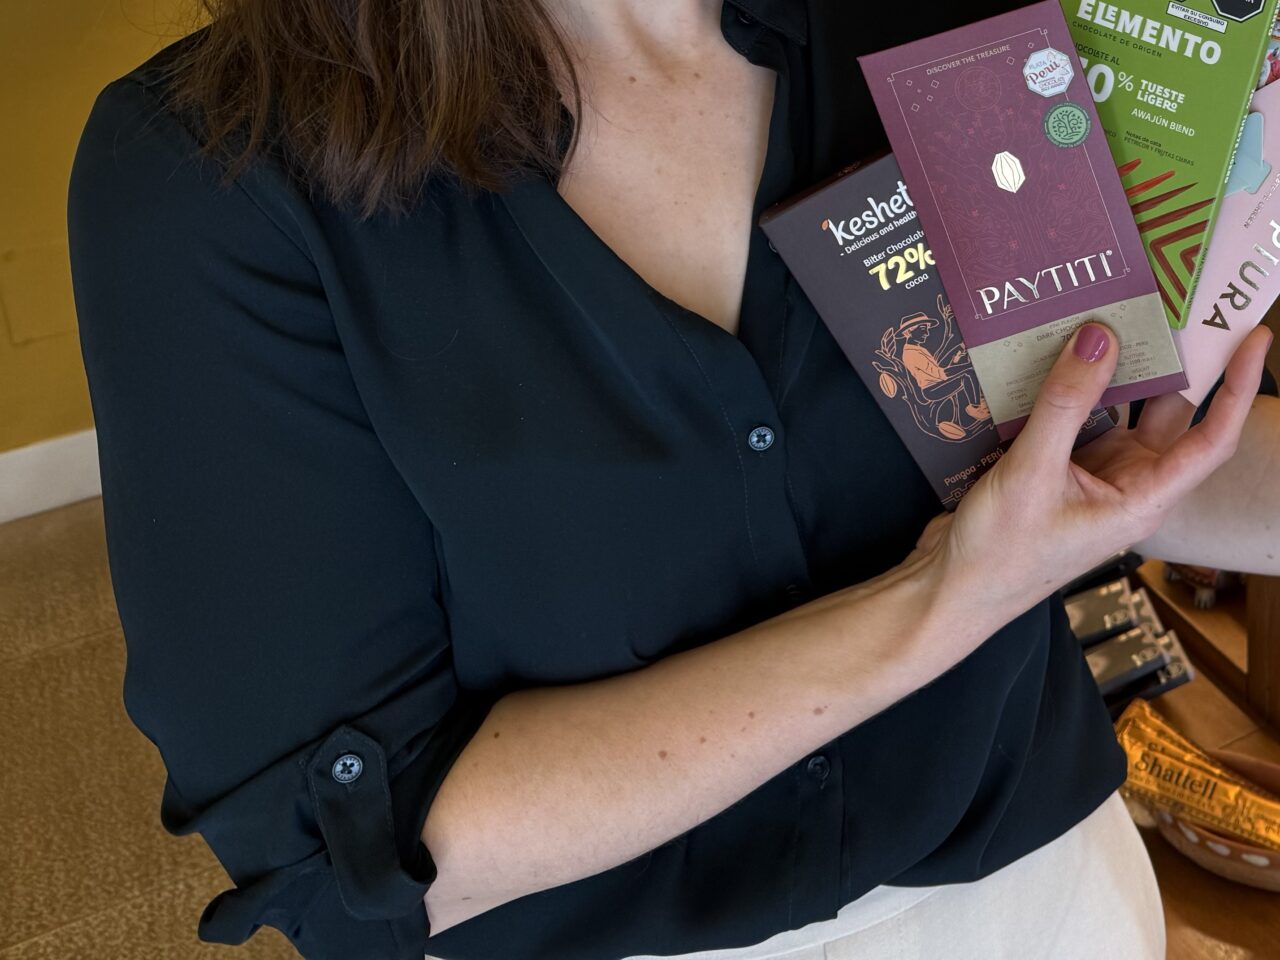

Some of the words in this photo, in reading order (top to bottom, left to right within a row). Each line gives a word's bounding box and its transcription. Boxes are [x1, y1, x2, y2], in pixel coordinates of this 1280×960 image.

[1171, 4, 1190, 14] EVITAR
[1198, 13, 1225, 26] CONSUMO
[1183, 15, 1209, 27] EXCESIVO
[1072, 21, 1117, 42] CHOCOLATE
[1119, 38, 1130, 46] DE
[1132, 42, 1162, 58] ORIGEN
[926, 60, 961, 76] DISCOVER
[962, 56, 976, 66] THE
[976, 44, 1010, 60] TREASURE
[1111, 57, 1120, 66] AL
[1139, 80, 1186, 104] TUESTE
[1131, 108, 1169, 127] AWAJÚN
[1169, 122, 1195, 137] BLEND
[1126, 130, 1141, 139] Notas
[1150, 139, 1162, 148] cata
[1155, 145, 1174, 159] FRUTAS
[827, 180, 915, 246] keshet
[844, 232, 879, 255] Delicious
[879, 222, 894, 236] and
[863, 251, 886, 268] Bitter
[868, 242, 936, 291] 72%
[905, 273, 929, 290] cocoa
[944, 465, 977, 486] Pangoa
[1134, 749, 1219, 801] Shattell
